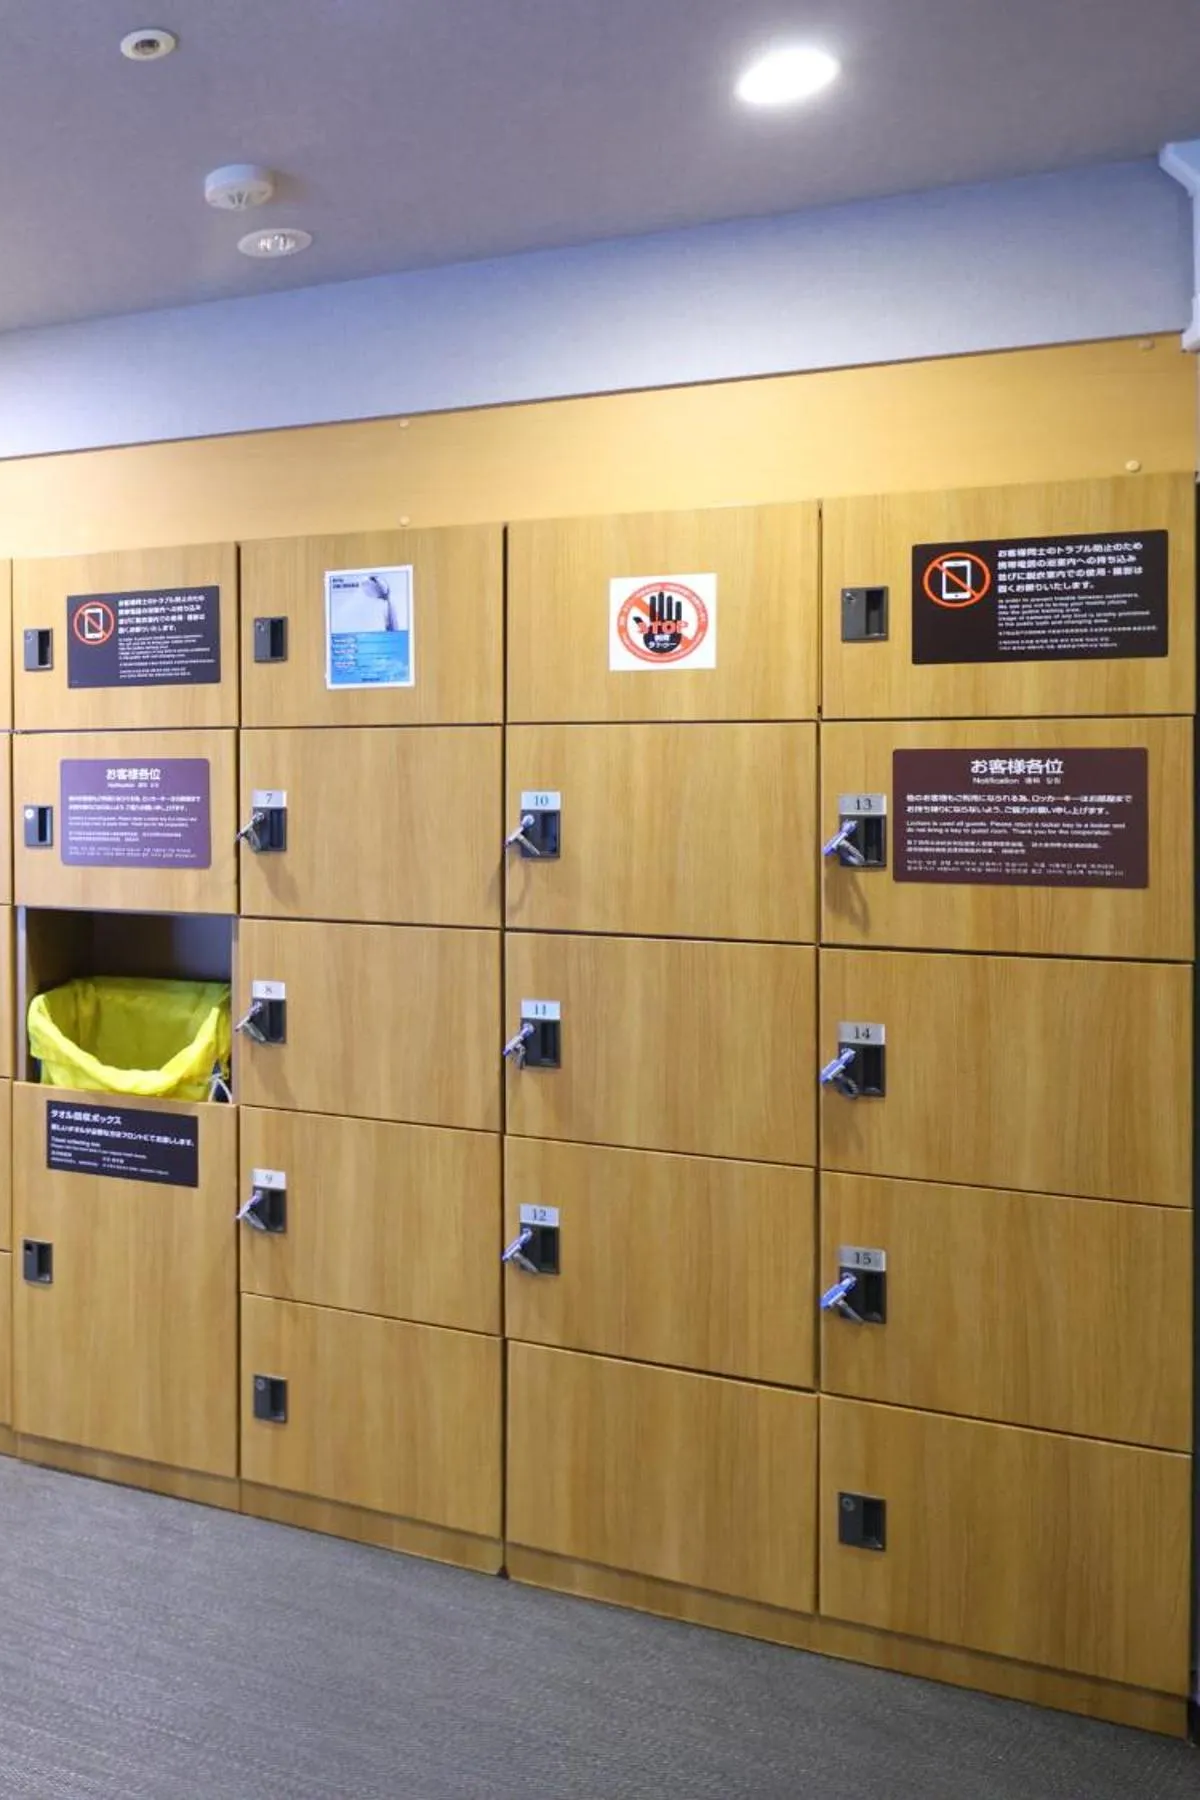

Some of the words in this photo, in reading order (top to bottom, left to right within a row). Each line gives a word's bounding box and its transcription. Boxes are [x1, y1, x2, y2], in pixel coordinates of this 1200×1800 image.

[970, 758, 1064, 775] お客様各位
[265, 793, 273, 805] 7
[534, 794, 549, 807] 10
[855, 798, 873, 810] 13
[534, 1003, 547, 1016] 11
[854, 1026, 871, 1039] 14
[264, 1173, 273, 1185] 9
[532, 1208, 547, 1221] 12
[855, 1252, 872, 1265] 15
